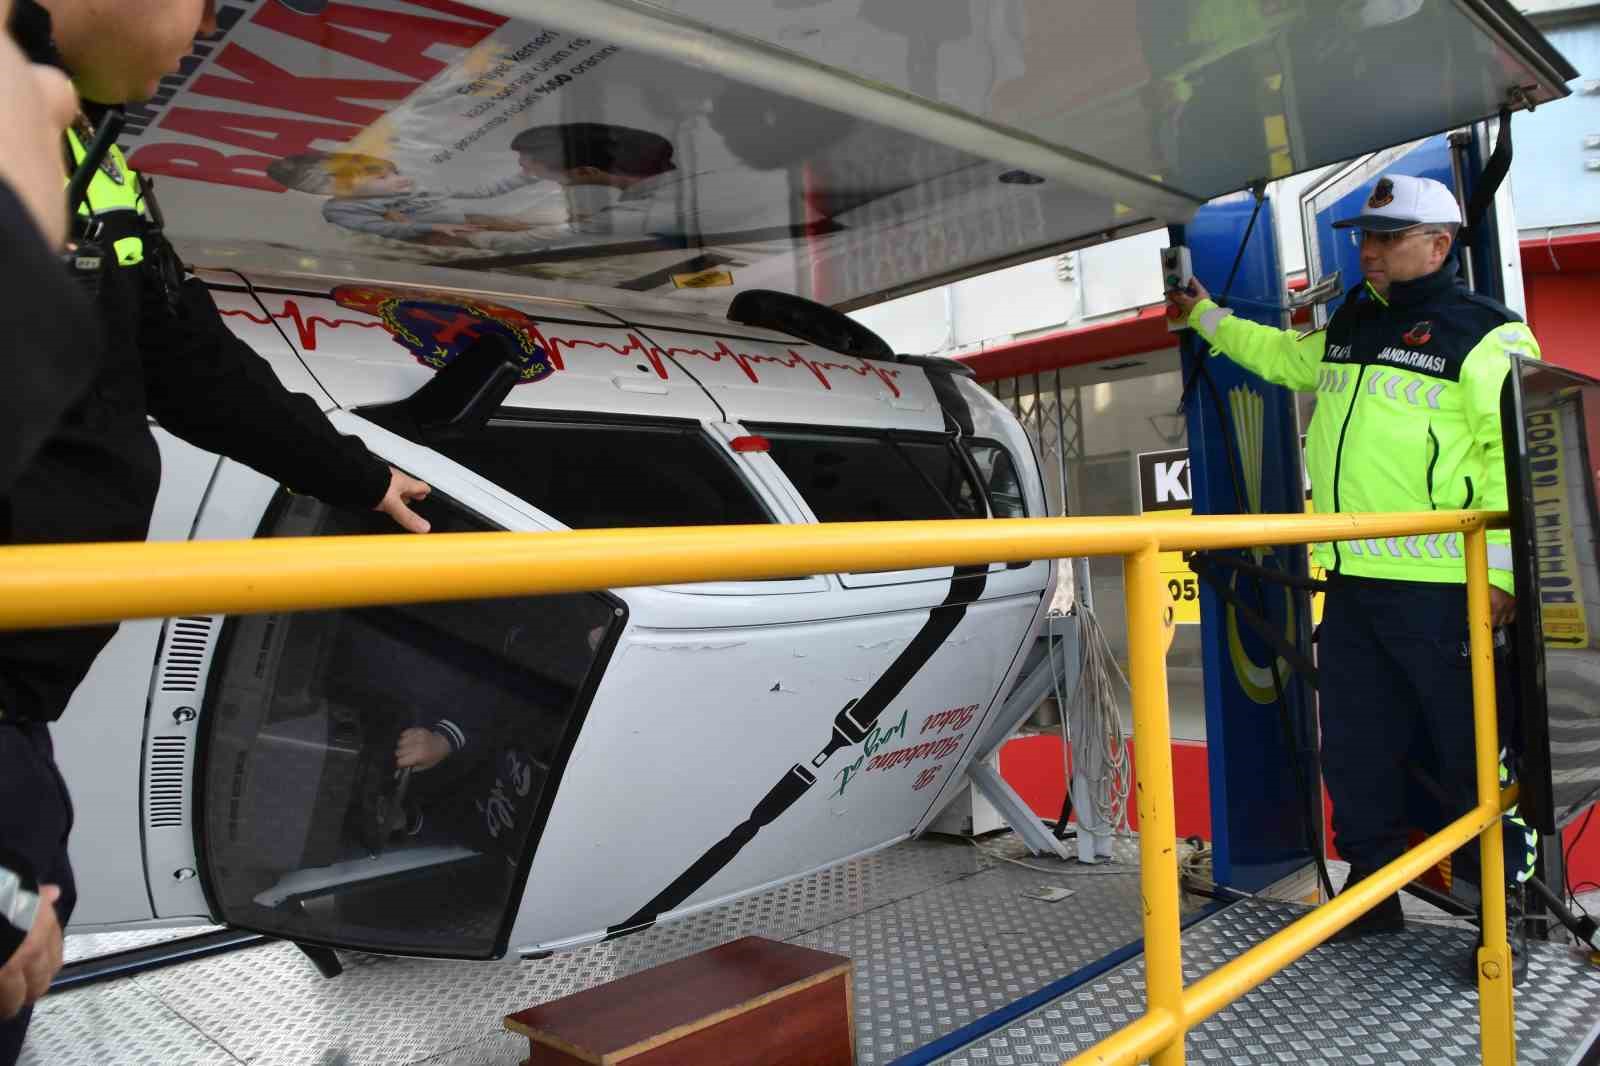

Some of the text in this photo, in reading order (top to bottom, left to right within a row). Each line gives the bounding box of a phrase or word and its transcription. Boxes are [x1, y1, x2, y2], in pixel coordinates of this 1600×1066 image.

[125, 0, 511, 193] BAKA
[1376, 346, 1447, 374] JANDARMASI
[1167, 577, 1200, 602] 05
